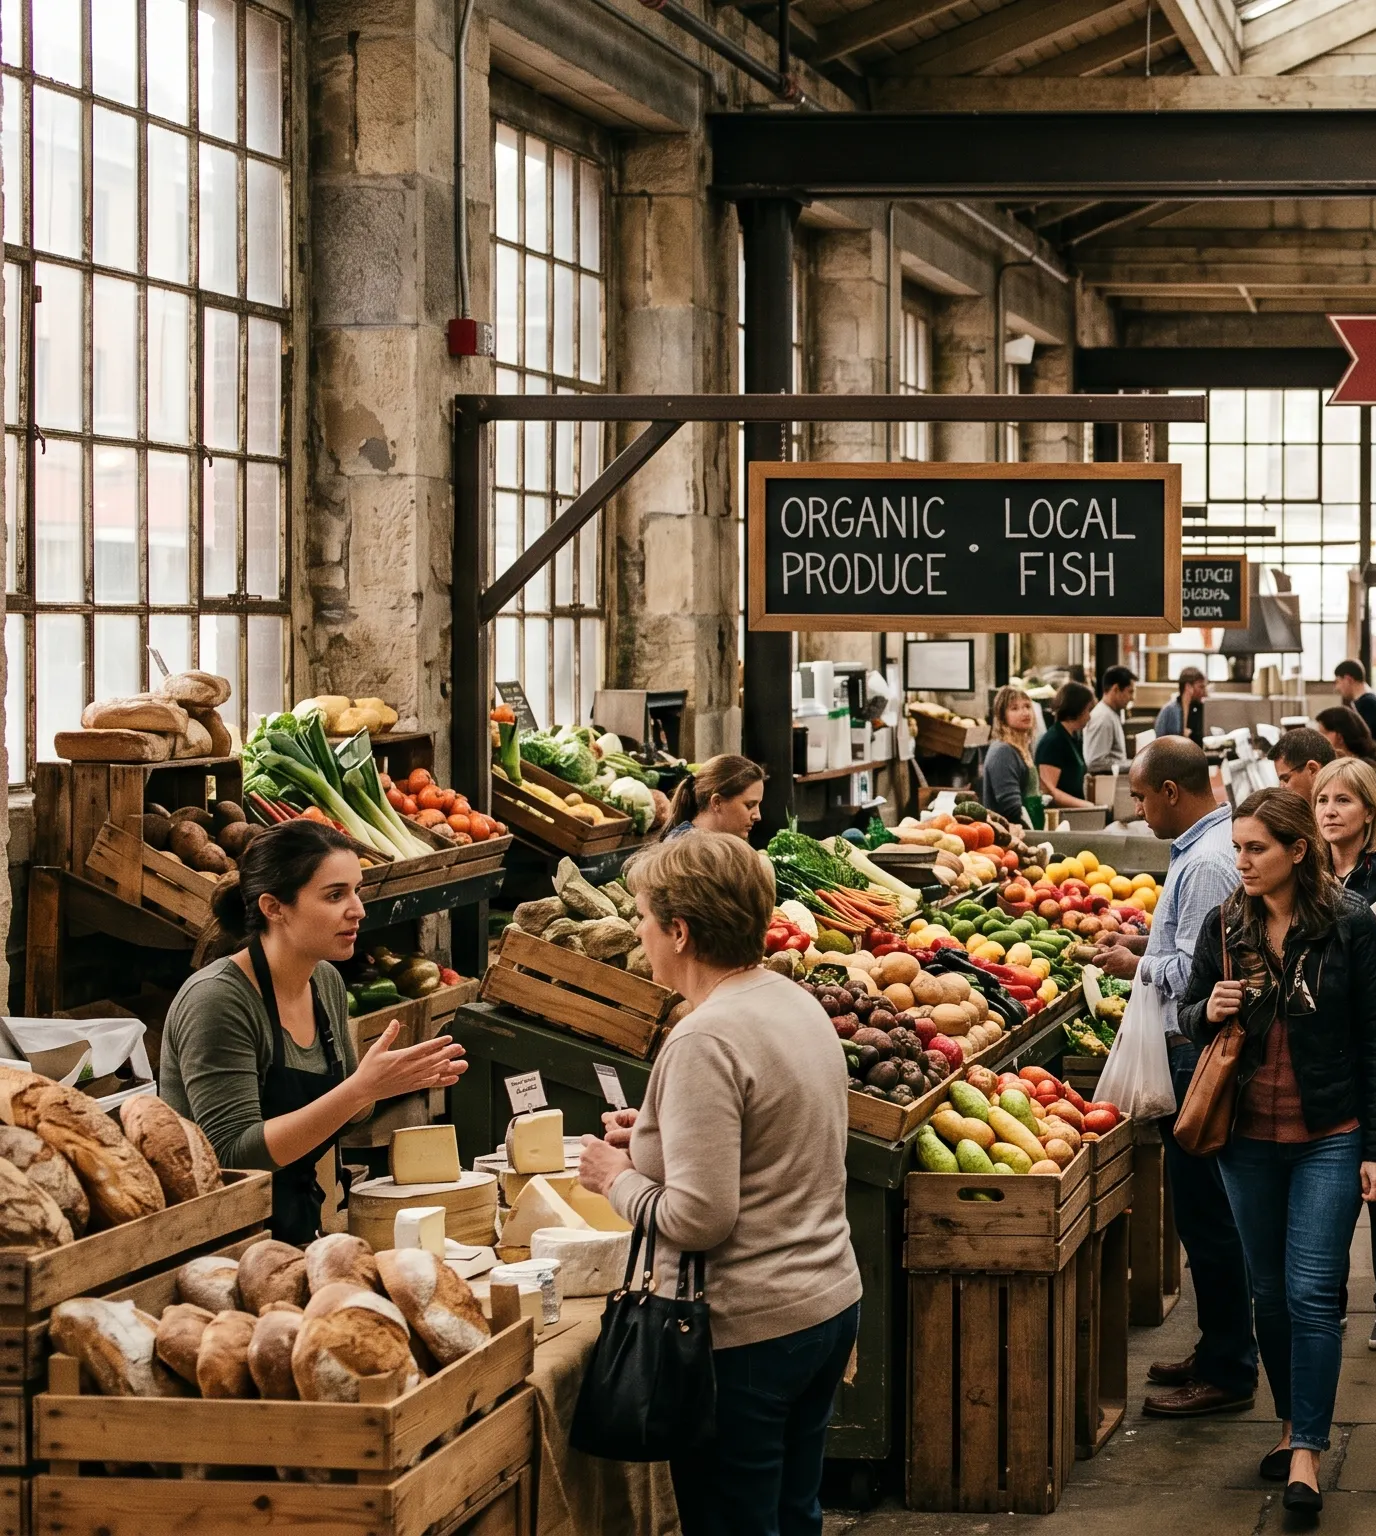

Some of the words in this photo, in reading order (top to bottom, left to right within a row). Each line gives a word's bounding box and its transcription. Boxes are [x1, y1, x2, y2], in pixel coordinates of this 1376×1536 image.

[781, 496, 946, 539] ORGANIC
[1005, 498, 1136, 539] LOCAL
[782, 552, 947, 596] PRODUCE
[1020, 552, 1115, 596] FISH
